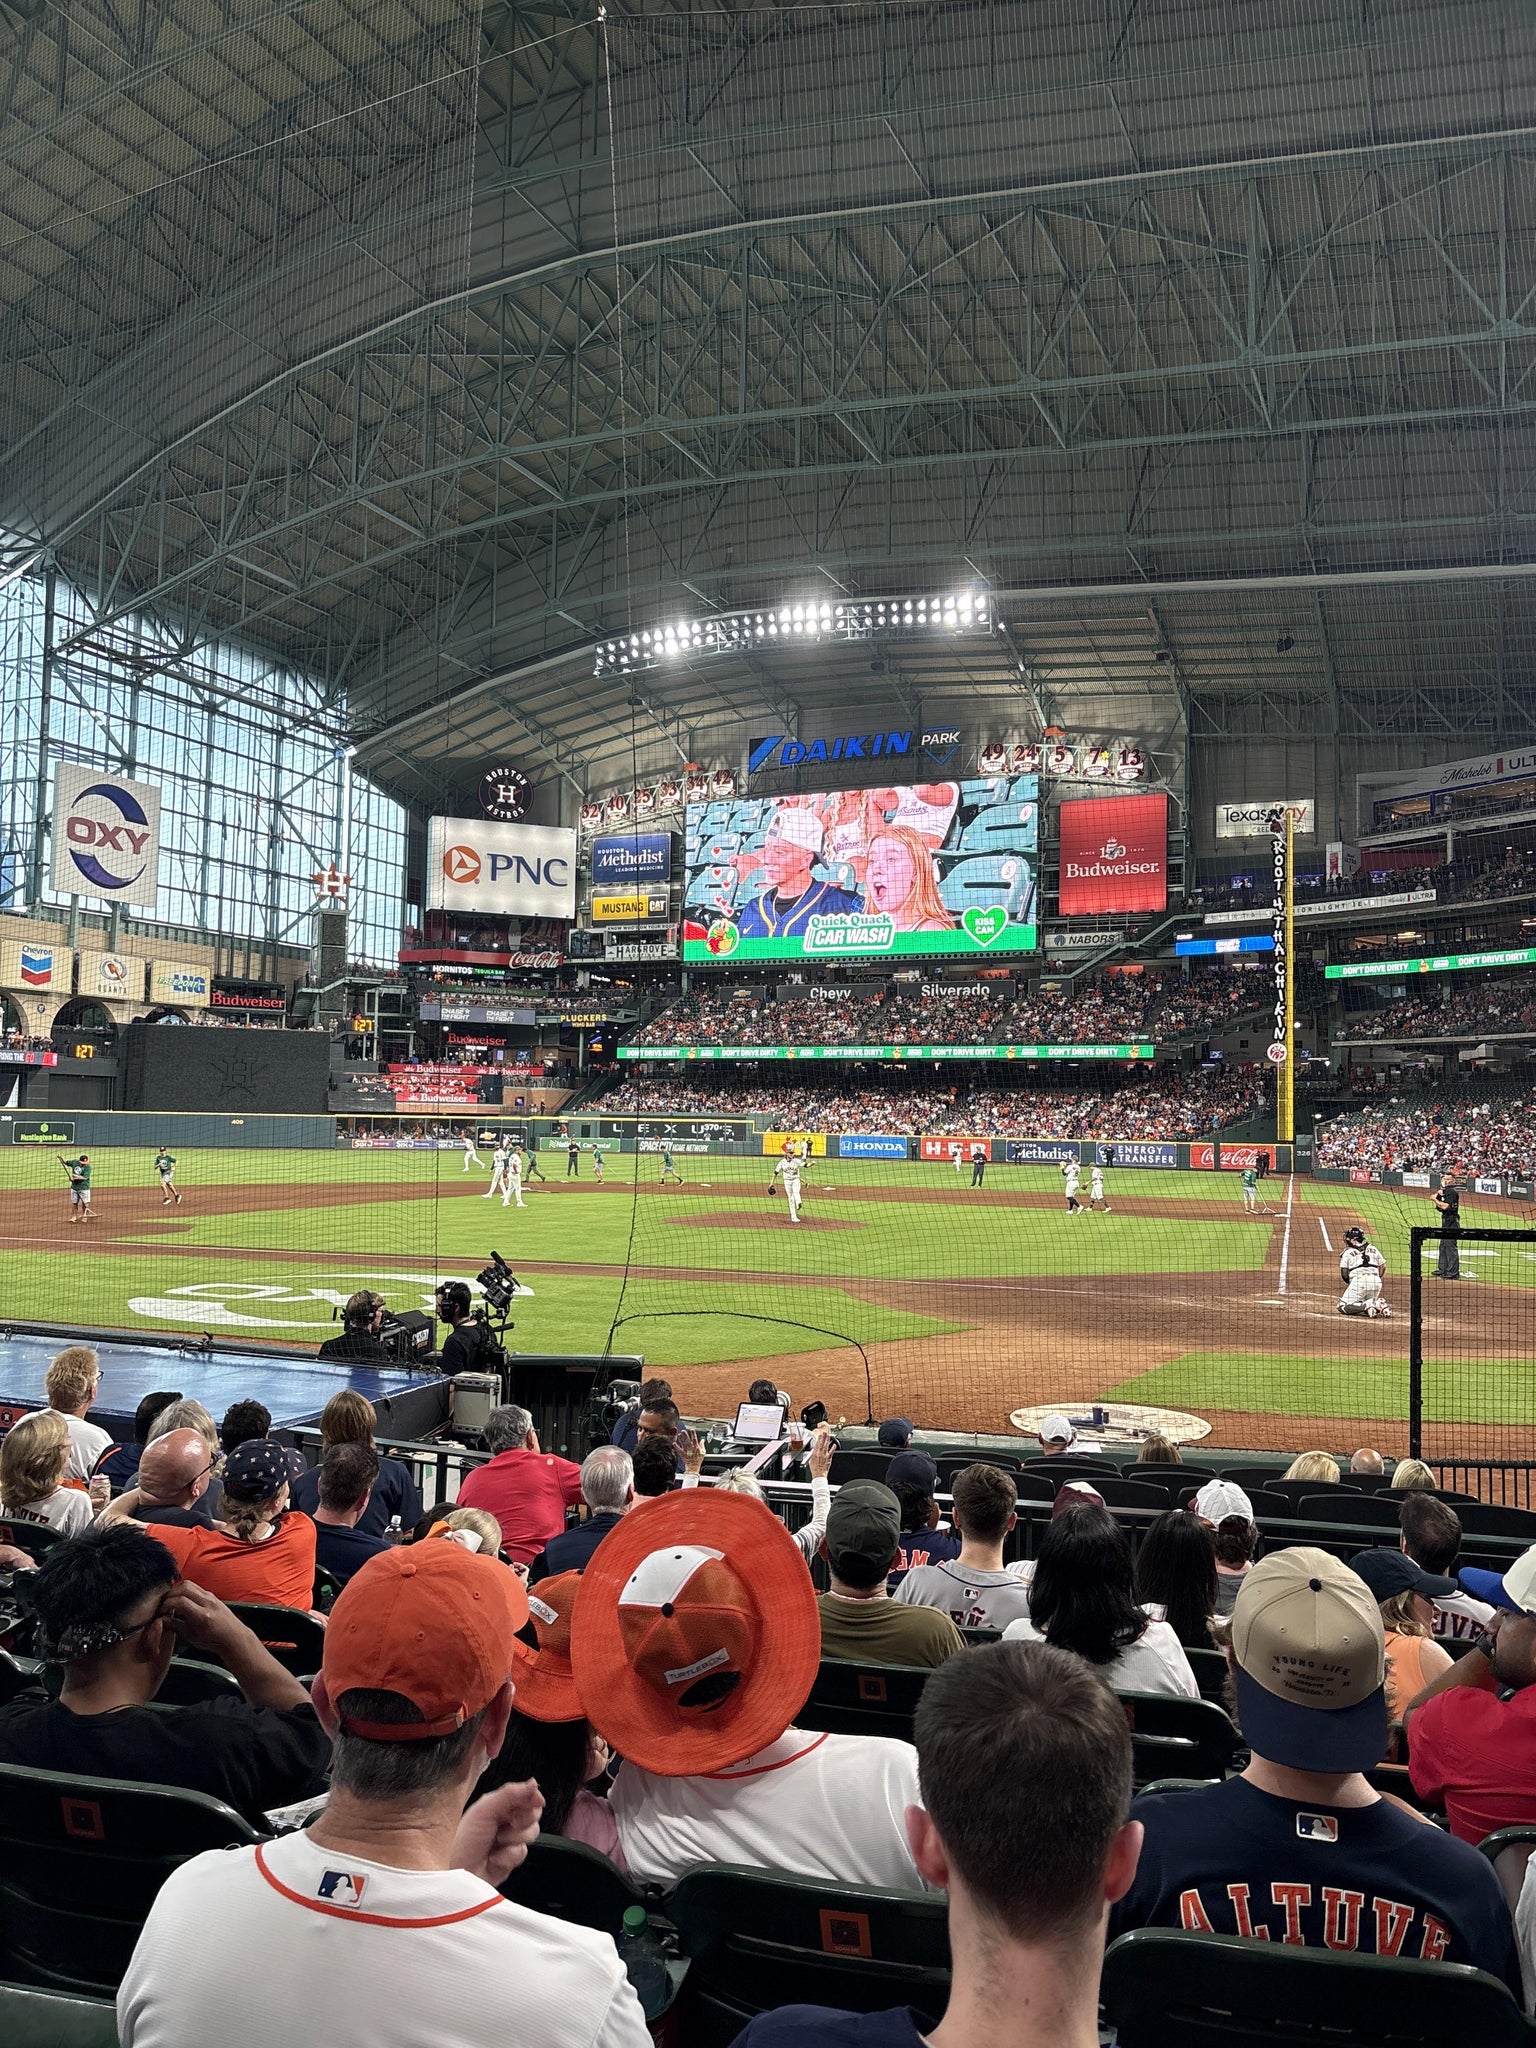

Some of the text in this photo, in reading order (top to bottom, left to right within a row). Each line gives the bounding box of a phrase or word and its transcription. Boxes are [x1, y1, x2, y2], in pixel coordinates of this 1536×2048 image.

[780, 731, 961, 765] DAIKIN PARK
[982, 744, 1004, 761] 49
[1014, 743, 1038, 761] 24
[1054, 745, 1066, 763] 5
[1089, 747, 1102, 765] 7
[1119, 749, 1142, 766] 13
[485, 768, 528, 786] HOUSTON
[1439, 763, 1493, 784] Michelob
[659, 781, 678, 797] 33
[686, 775, 706, 791] 34
[606, 795, 625, 811] 40
[486, 804, 525, 819] ASTROS
[581, 803, 599, 819] 32
[1223, 806, 1266, 823] Texas
[67, 817, 150, 855] OXY
[597, 849, 665, 867] Methodist
[487, 853, 568, 887] PNC
[1272, 841, 1286, 892] ROOT
[1412, 892, 1435, 903] ULTRA
[602, 900, 665, 914] MUSTANG CAT
[811, 914, 891, 928] Quick Quack
[974, 917, 995, 926] KISS
[814, 928, 889, 945] CAR WASH
[974, 926, 995, 935] CAM
[1068, 934, 1115, 944] NABORS
[22, 945, 53, 955] Chevron
[616, 945, 667, 958] HARGROVE
[1457, 957, 1482, 965] DON'T
[1482, 955, 1505, 964] DRIVE
[1505, 952, 1529, 962] DIRTY
[432, 965, 474, 974] HORNITOS
[1342, 963, 1409, 975] DON'T DRIVE DIRTY
[173, 974, 206, 994] LNG
[810, 983, 990, 1000] Chevy Silverado
[211, 992, 285, 1008] Budweiser
[1273, 961, 1286, 1041] CHIKIN
[354, 1020, 372, 1031] 1:27
[560, 1014, 607, 1022] PLUCKERS
[447, 1033, 508, 1046] Budweiser
[75, 1044, 94, 1058] 1:27
[416, 1065, 462, 1074] Budweiser
[420, 1094, 468, 1103] Budweiser
[704, 1123, 720, 1131] 370
[52, 1133, 67, 1141] Bank
[640, 1141, 660, 1151] SPACE
[854, 1142, 904, 1151] HONDA
[1012, 1146, 1073, 1160] Methodist
[1118, 1145, 1163, 1154] ENERGY
[1118, 1154, 1174, 1163] TRANSFER
[669, 1655, 726, 1679] TURTLEBOX
[1273, 1656, 1351, 1676] YOUNG LIFE
[1179, 1882, 1452, 1961] ALTUVE
